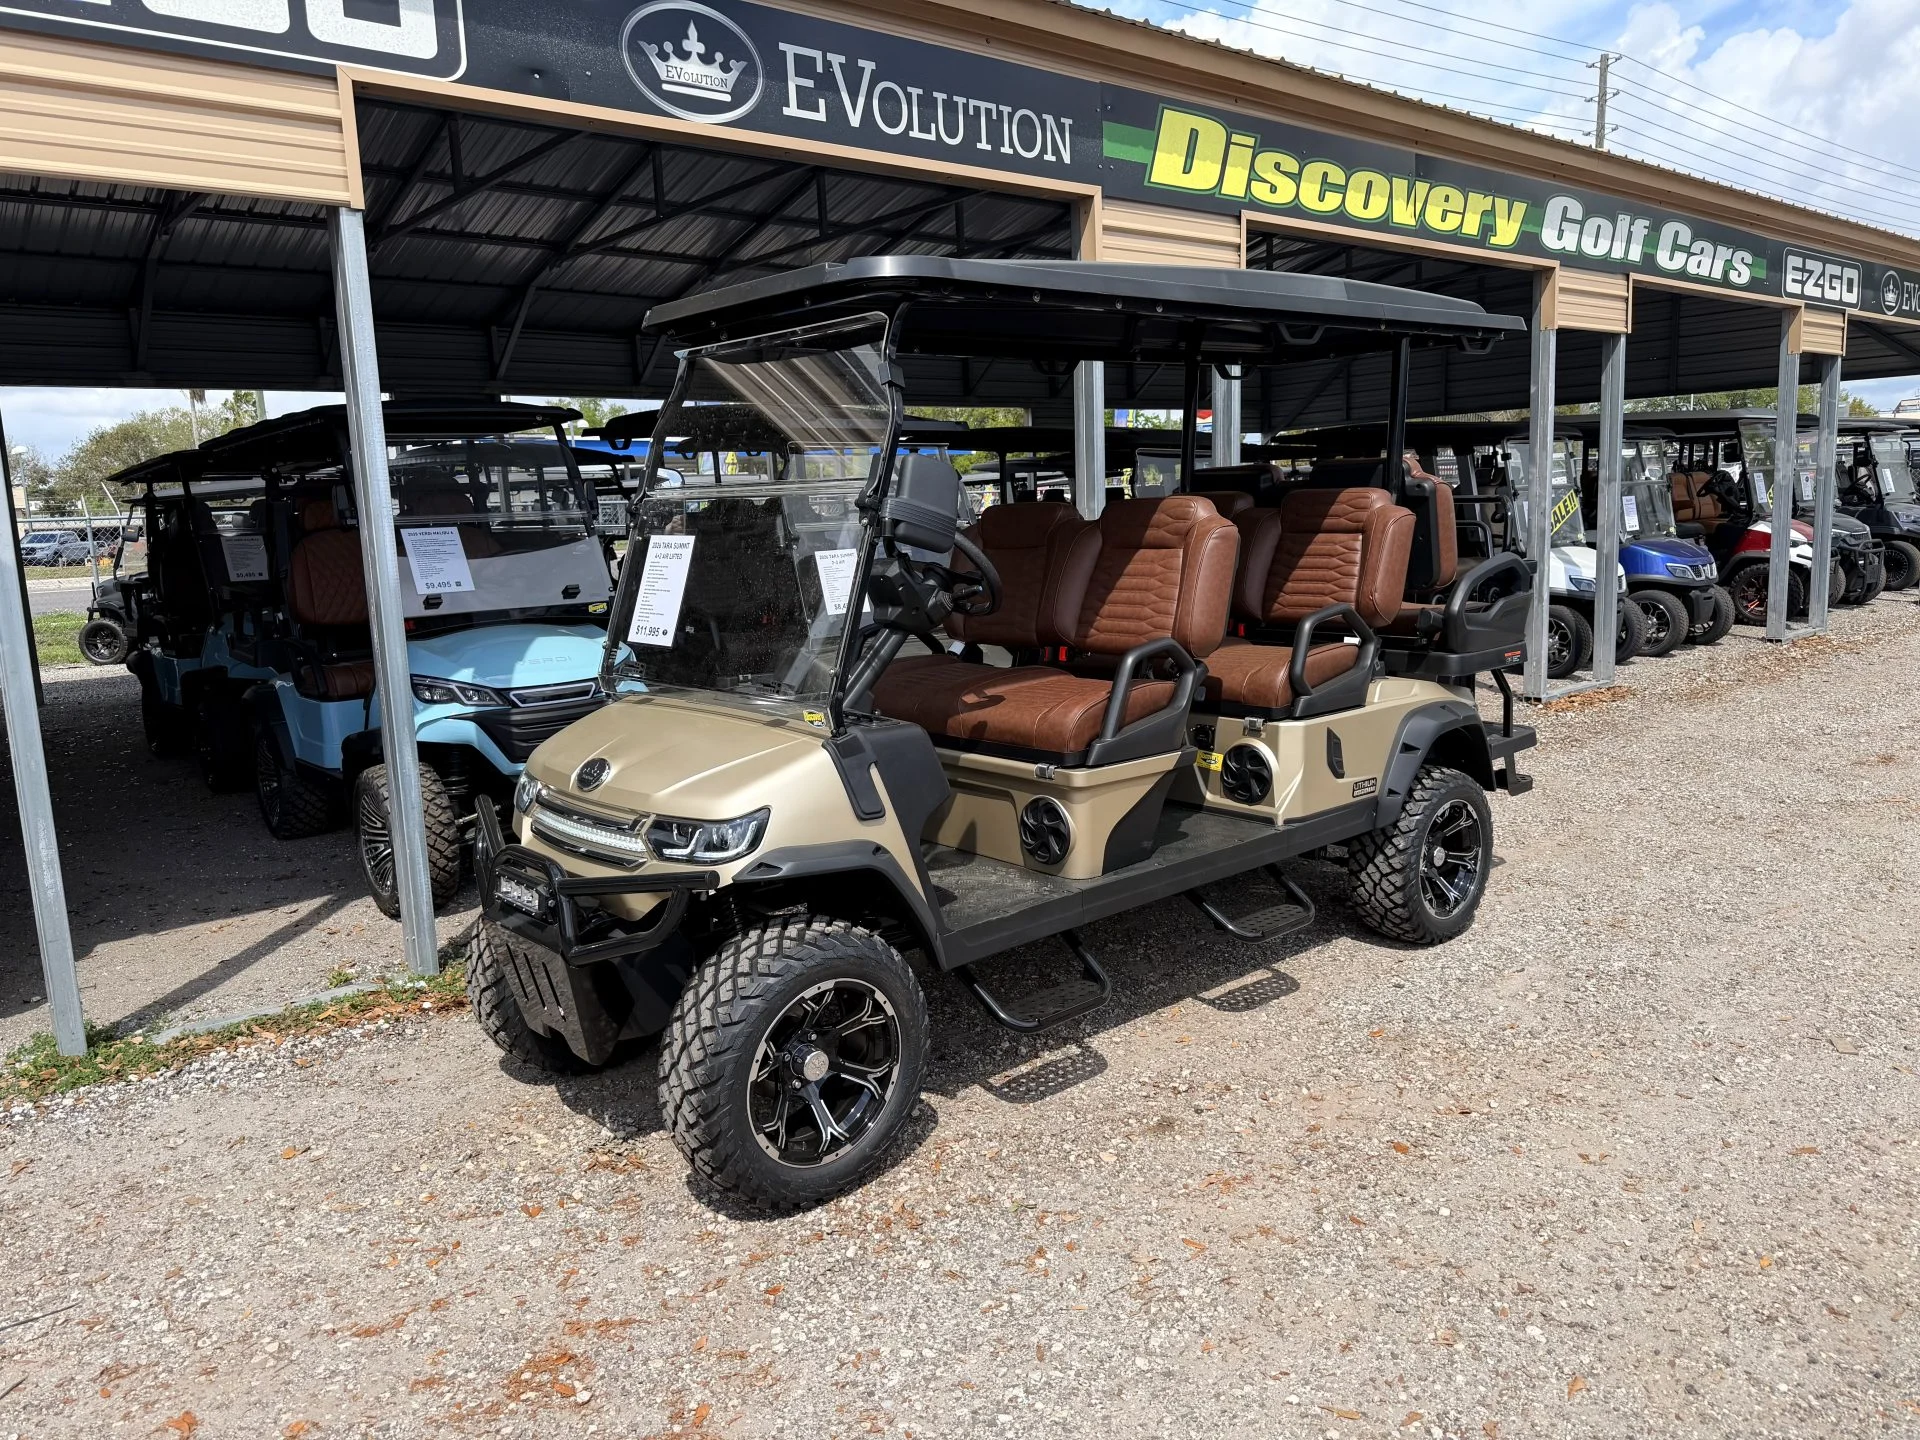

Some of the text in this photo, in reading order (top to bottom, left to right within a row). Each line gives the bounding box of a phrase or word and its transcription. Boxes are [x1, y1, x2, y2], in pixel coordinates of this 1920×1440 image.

[1149, 108, 1753, 286] Discovery Golf Cars
[1785, 254, 1859, 304] EZGO
[834, 603, 848, 611] $8,4
[636, 625, 660, 637] $11,995
[1353, 779, 1376, 790] LITHIUM
